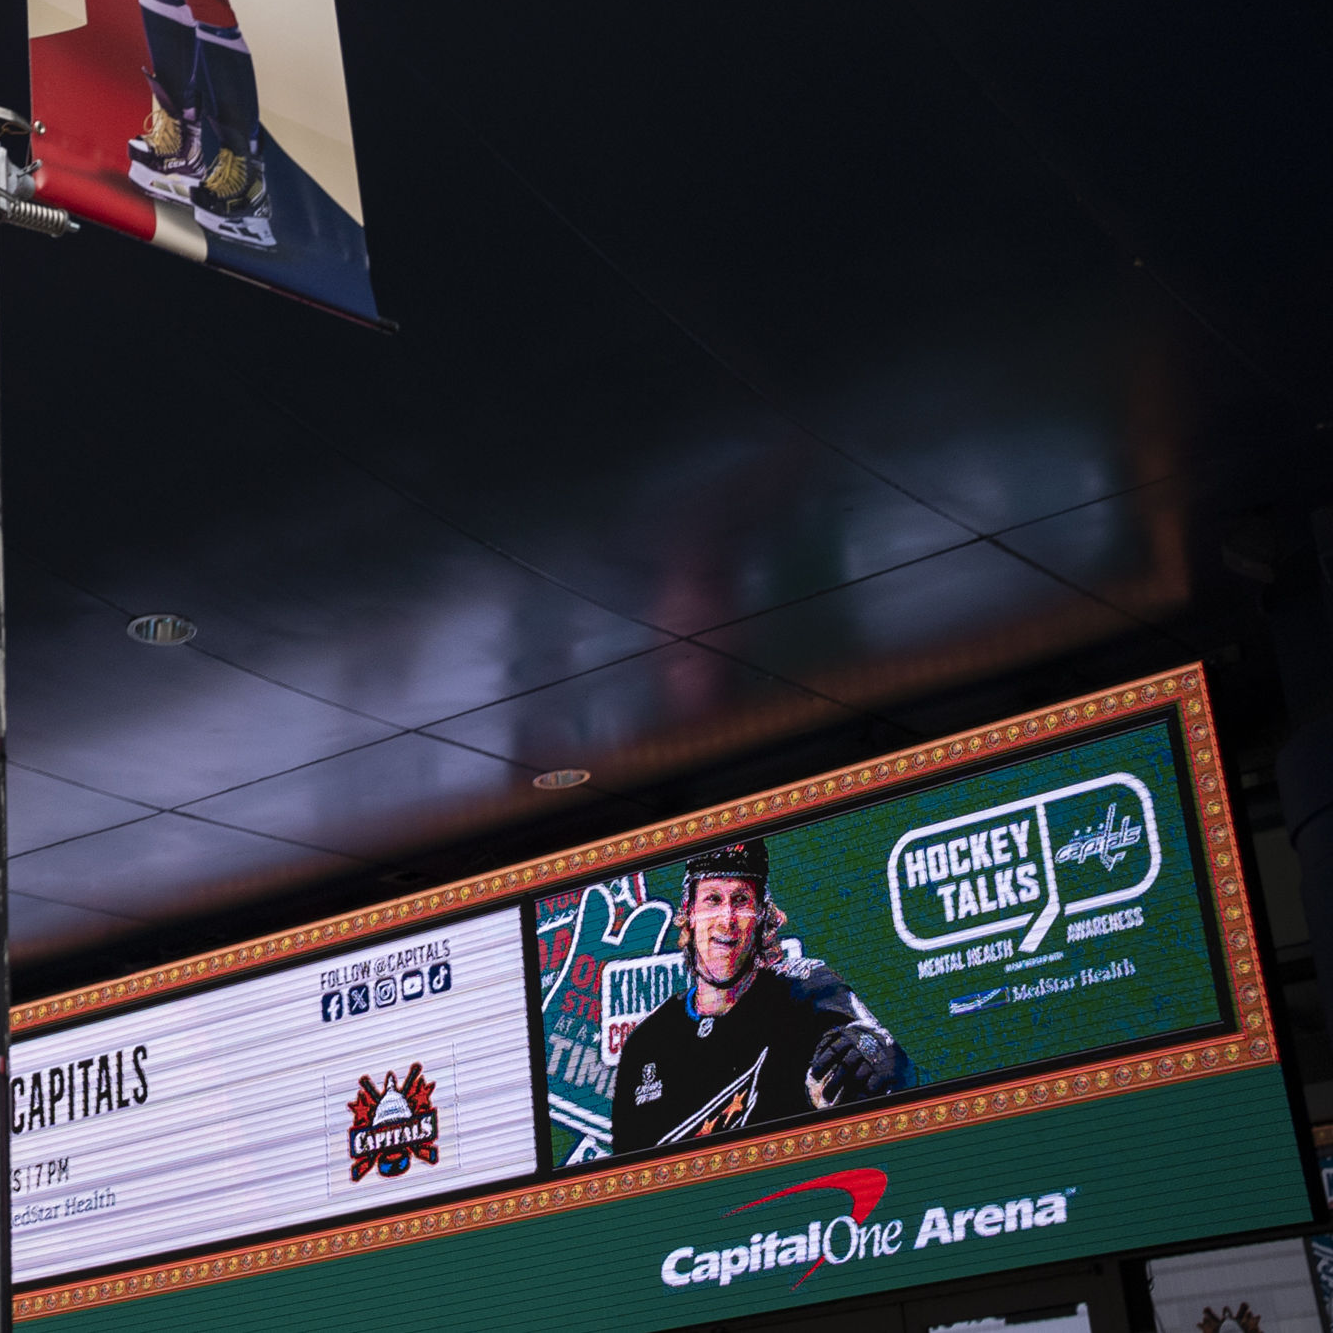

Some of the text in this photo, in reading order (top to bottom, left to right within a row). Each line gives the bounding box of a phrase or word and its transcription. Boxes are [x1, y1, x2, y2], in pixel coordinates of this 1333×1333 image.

[904, 819, 1030, 889] HOCKEY
[936, 862, 1041, 923] TALKS
[1066, 906, 1145, 944] AWARENESS
[320, 938, 451, 991] FOLLOW @CAPITALS
[917, 950, 966, 980] MENTAL
[966, 938, 1015, 968] HEALTH
[1011, 974, 1077, 1003] MedStar
[1079, 958, 1136, 987] Health
[10, 1045, 149, 1135] CAPITALS
[353, 1115, 433, 1155] CAPITALS
[48, 1156, 70, 1186] PM
[11, 1187, 117, 1228] edStar Health
[913, 1191, 1069, 1251] Arena
